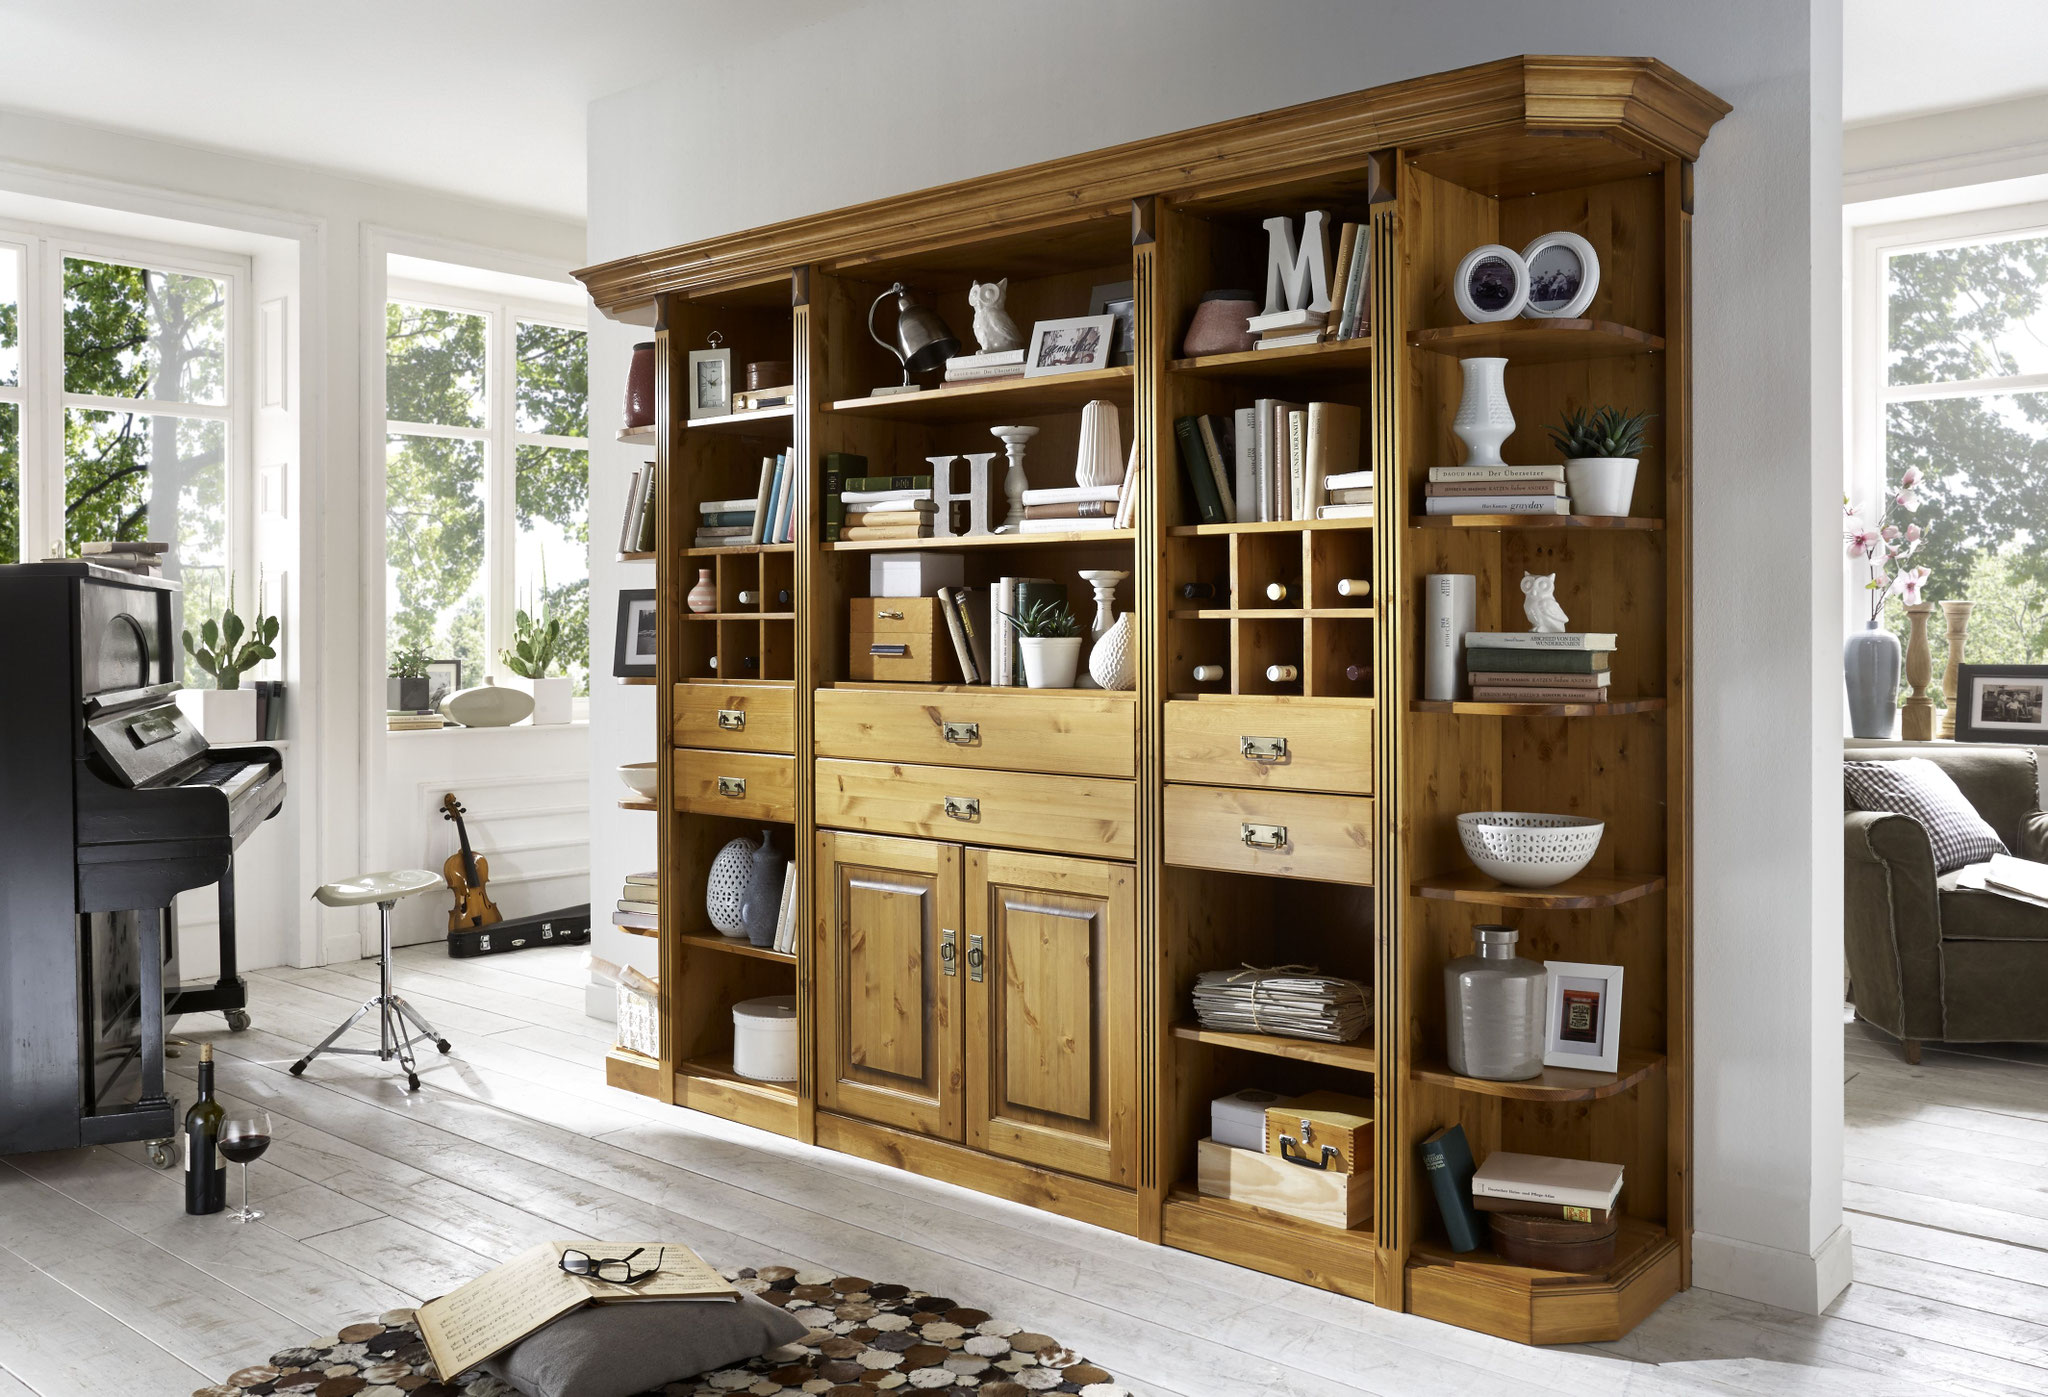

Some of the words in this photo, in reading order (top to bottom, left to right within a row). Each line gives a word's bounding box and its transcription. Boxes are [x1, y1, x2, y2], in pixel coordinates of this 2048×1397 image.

[1260, 210, 1331, 315] M
[925, 452, 1000, 538] H
[1504, 469, 1544, 477] Übersetzer
[1510, 501, 1545, 512] grayday
